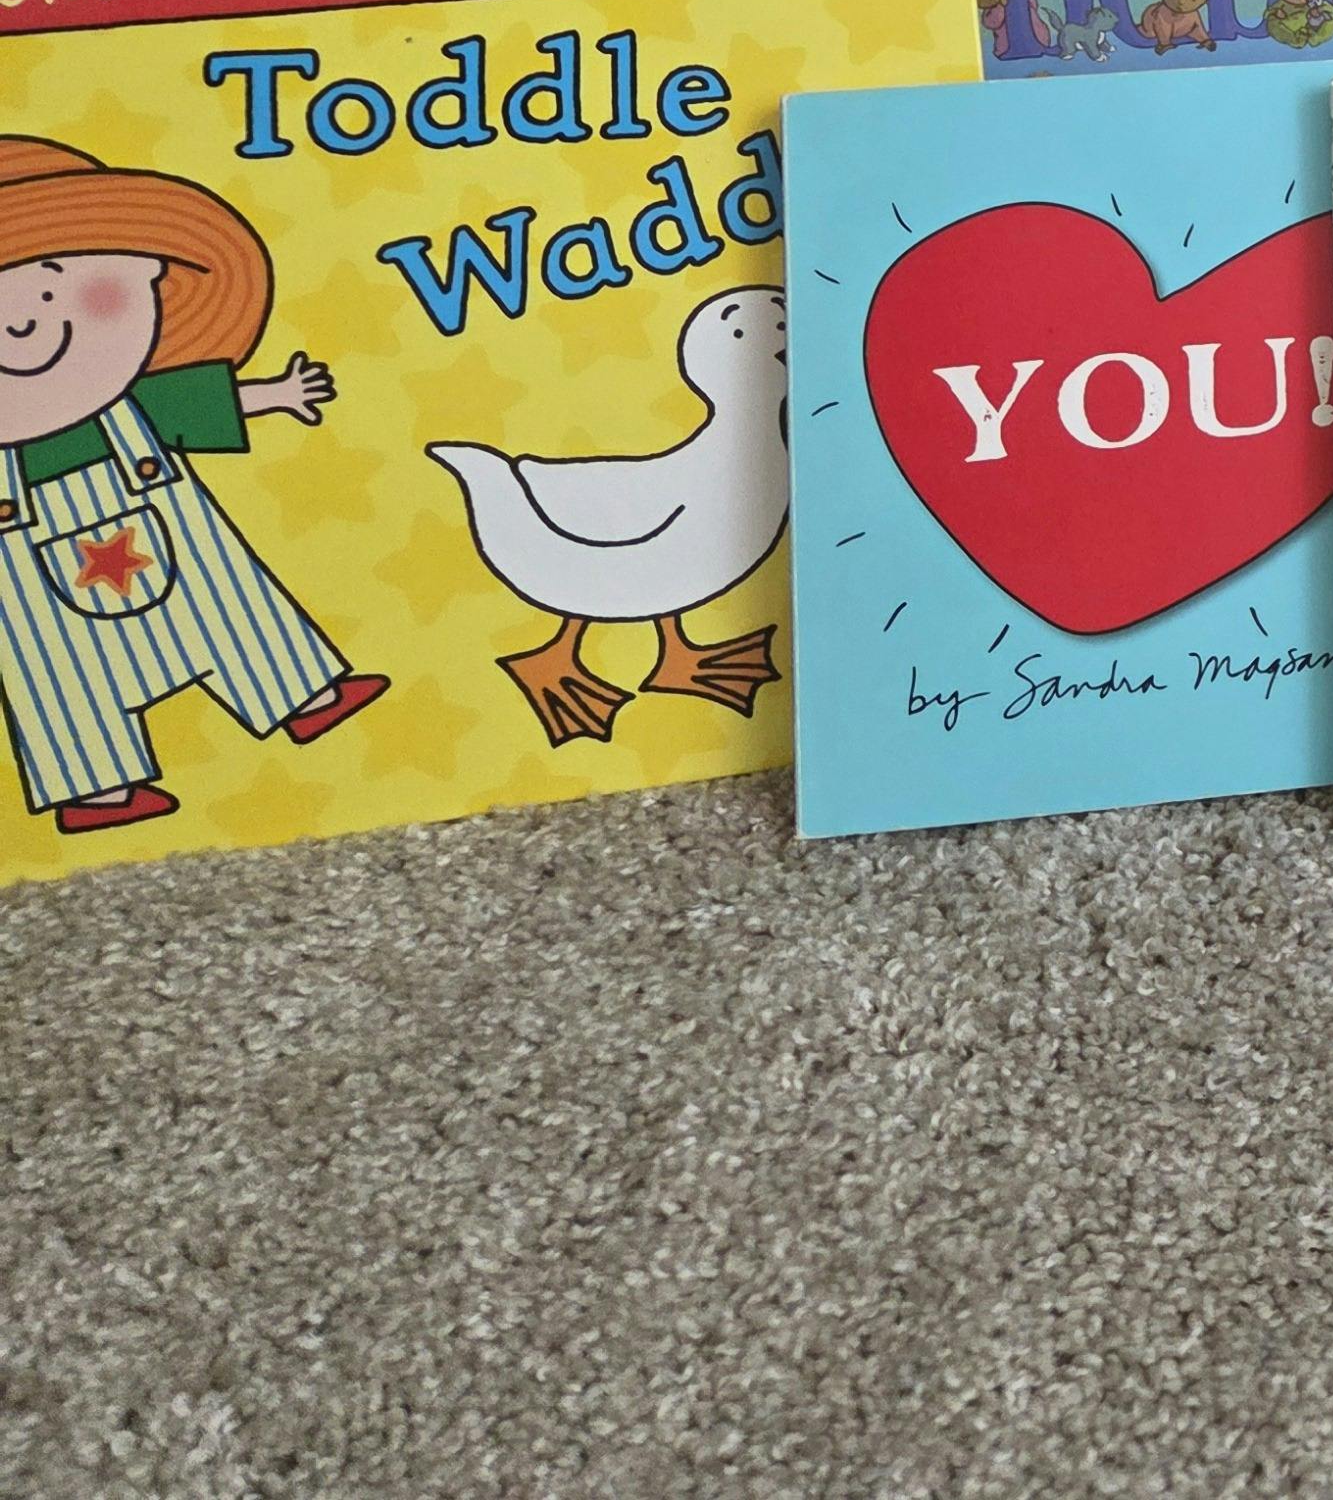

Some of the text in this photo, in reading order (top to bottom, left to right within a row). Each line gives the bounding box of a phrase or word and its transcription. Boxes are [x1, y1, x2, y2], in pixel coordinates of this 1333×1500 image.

[204, 29, 732, 160] Toddle
[378, 129, 784, 338] Wadd
[907, 666, 990, 731] by
[1003, 653, 1169, 719] Sandra
